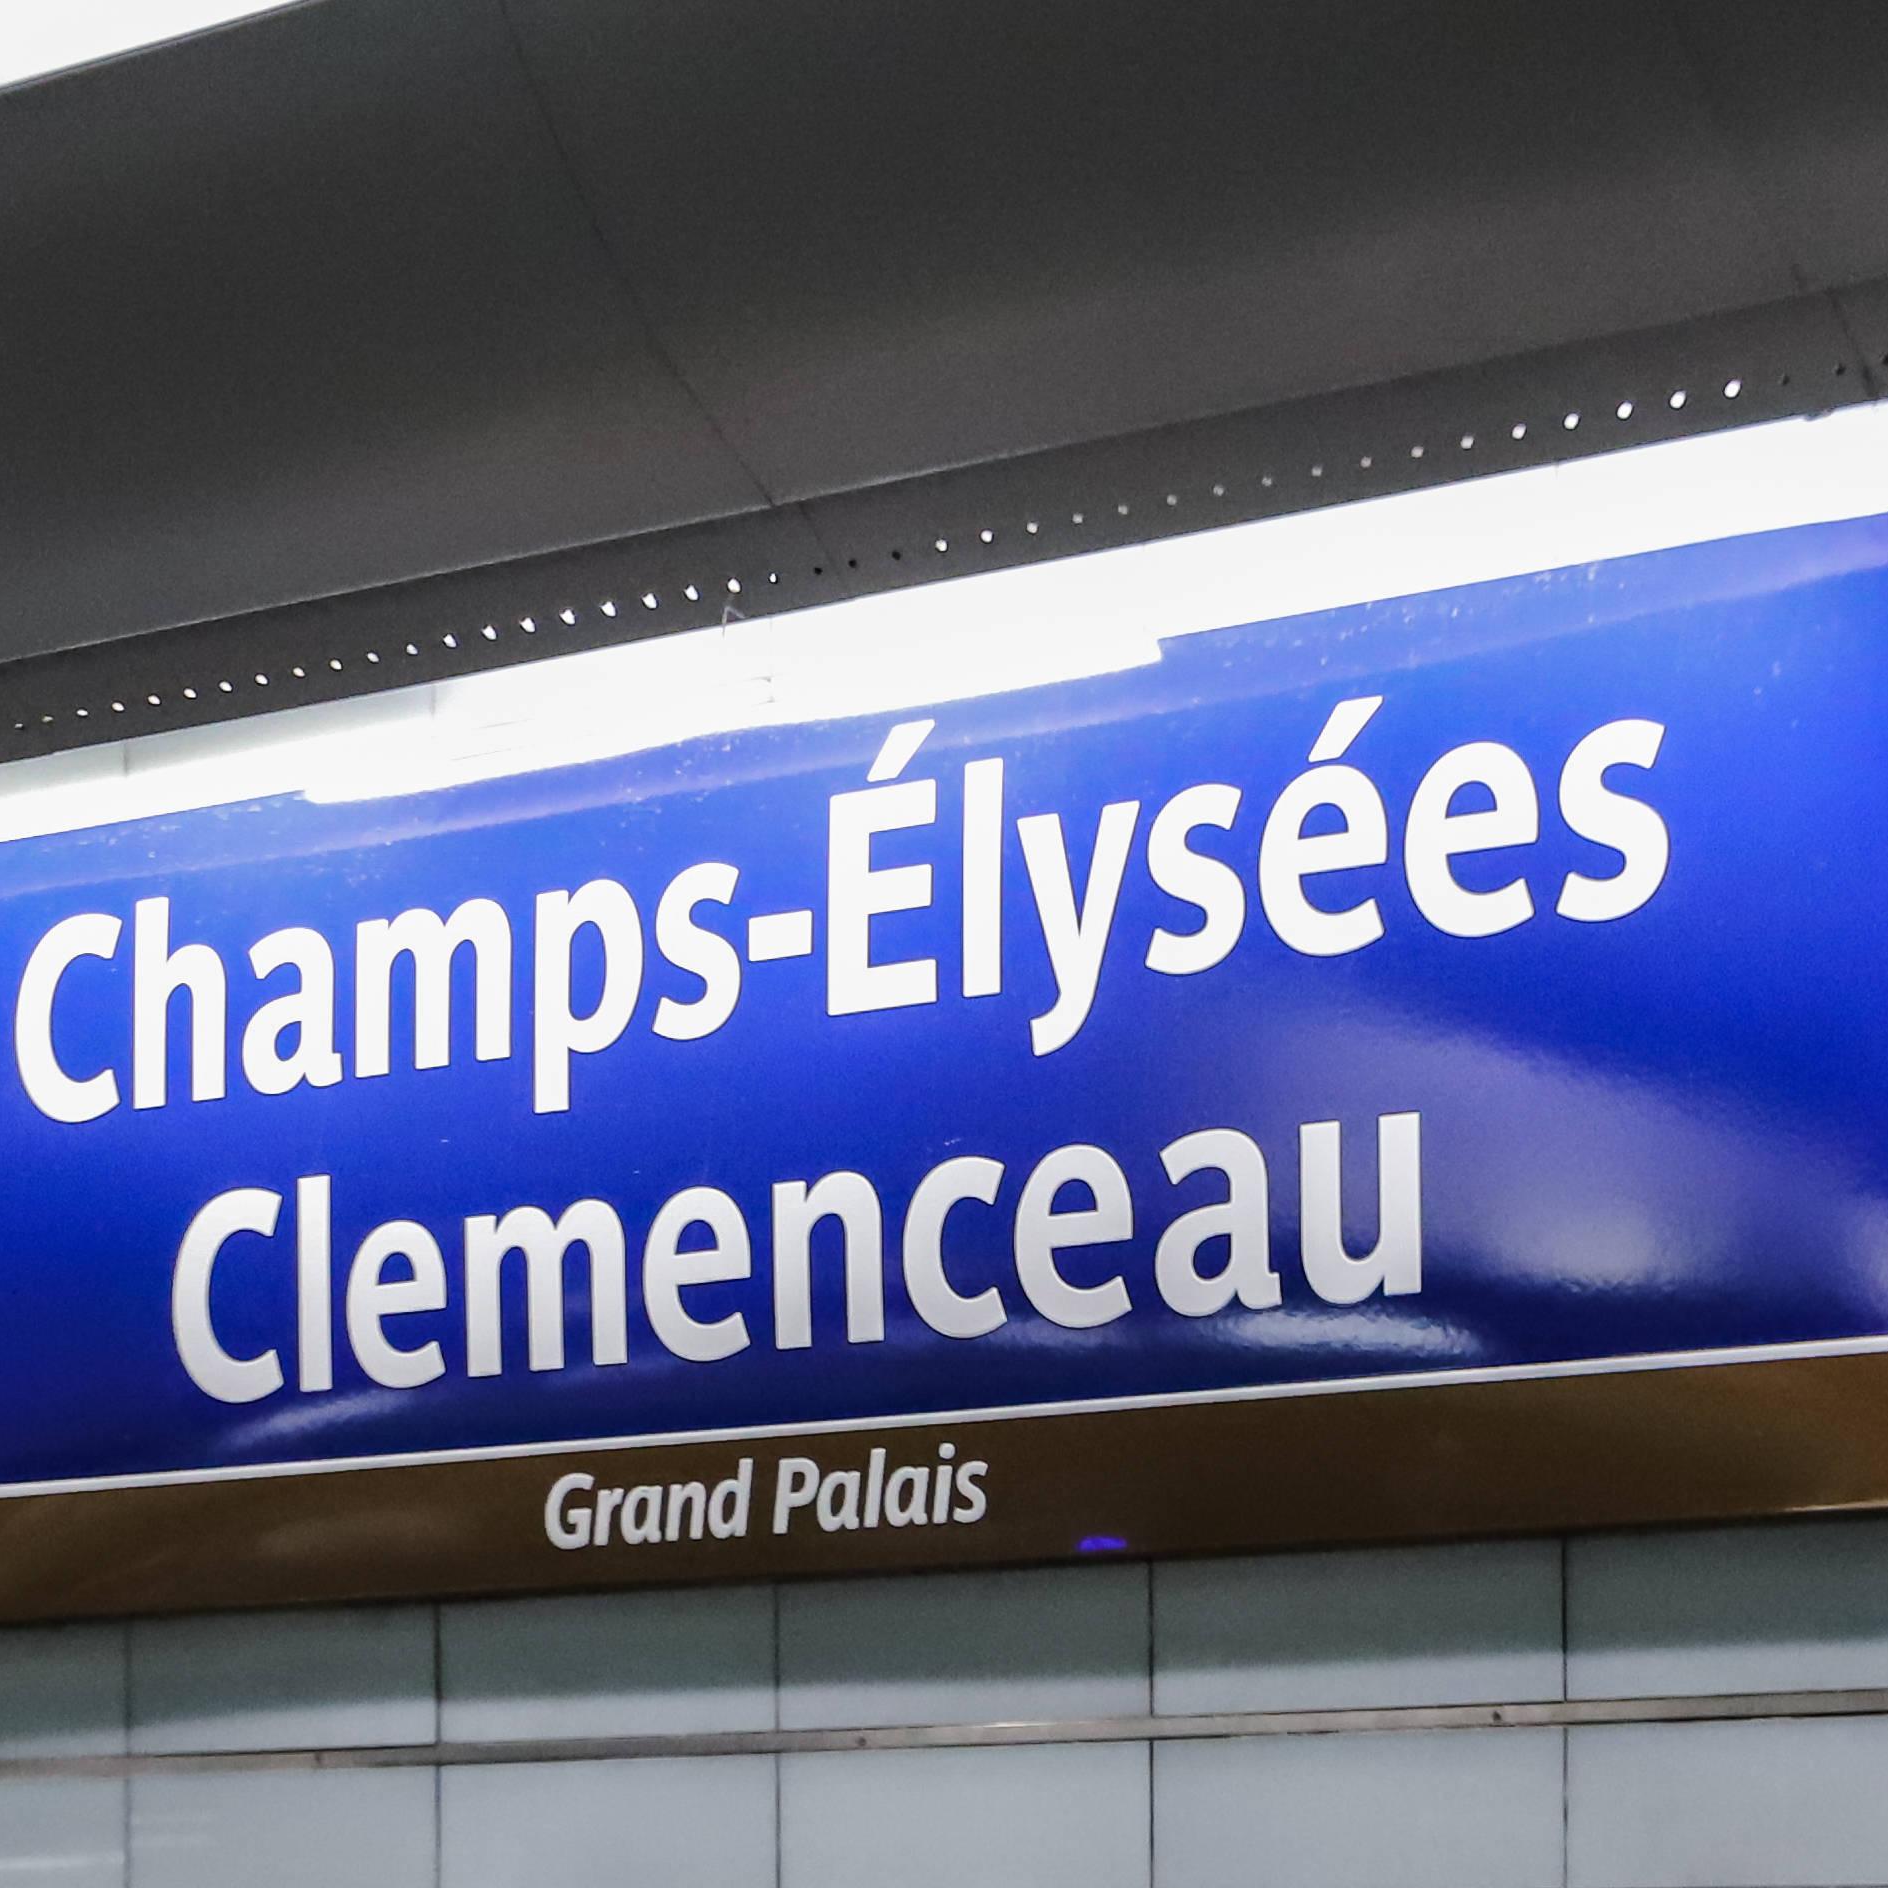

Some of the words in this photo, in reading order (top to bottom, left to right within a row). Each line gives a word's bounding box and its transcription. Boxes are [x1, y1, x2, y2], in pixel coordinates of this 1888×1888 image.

[13, 696, 1671, 1124] Champs-Élysées
[171, 1111, 1424, 1404] Clemenceau
[543, 1456, 755, 1551] Grand
[771, 1446, 990, 1535] Palais
